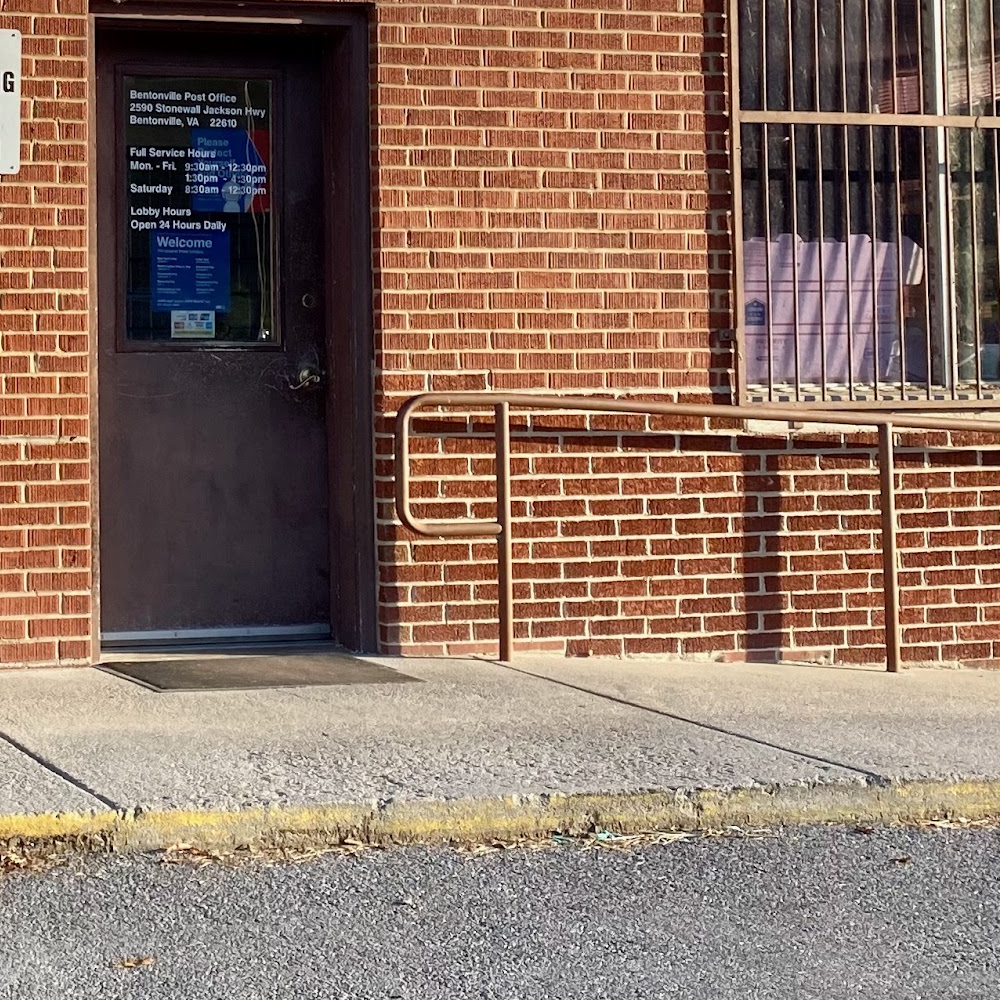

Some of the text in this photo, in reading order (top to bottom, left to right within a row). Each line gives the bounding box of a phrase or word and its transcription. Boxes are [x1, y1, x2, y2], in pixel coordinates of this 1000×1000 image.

[129, 90, 237, 103] Bentonville Post Office
[129, 103, 266, 118] 2590 Stonewall Jackson Hwy
[129, 115, 237, 128] Bentonville, VA 22610
[197, 138, 229, 146] Please
[129, 147, 216, 158] Full Service Hours
[130, 161, 153, 170] Mon.
[162, 161, 177, 170] Fri.
[184, 162, 219, 172] 9:30am
[228, 163, 267, 174] 12:30pm
[185, 174, 218, 184] 1:30pm
[231, 174, 267, 185] 4:30pm
[130, 184, 173, 195] Saturday
[184, 185, 219, 194] 8:30am
[228, 185, 267, 196] 12:30pm
[131, 206, 191, 218] Lobby Hours
[131, 220, 227, 232] Open 24 Hours Daily
[157, 236, 212, 248] Welcome
